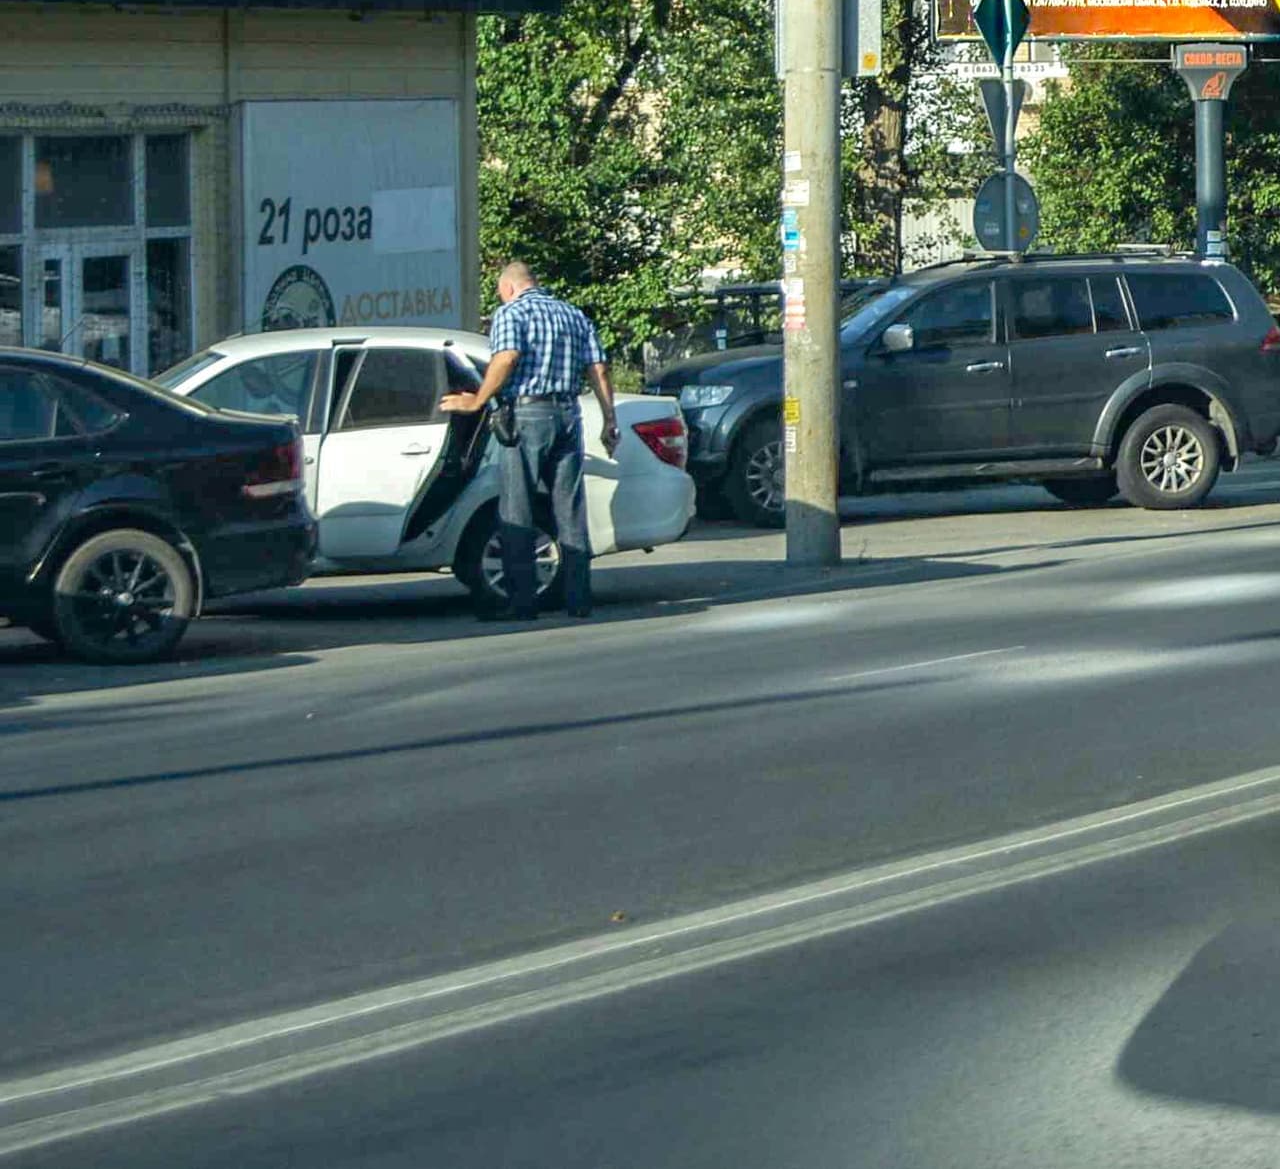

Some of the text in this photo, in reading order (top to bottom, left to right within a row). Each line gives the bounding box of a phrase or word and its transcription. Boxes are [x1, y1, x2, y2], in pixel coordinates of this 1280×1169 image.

[258, 197, 373, 256] 21 роза
[339, 287, 454, 328] ДОСТАВКА
